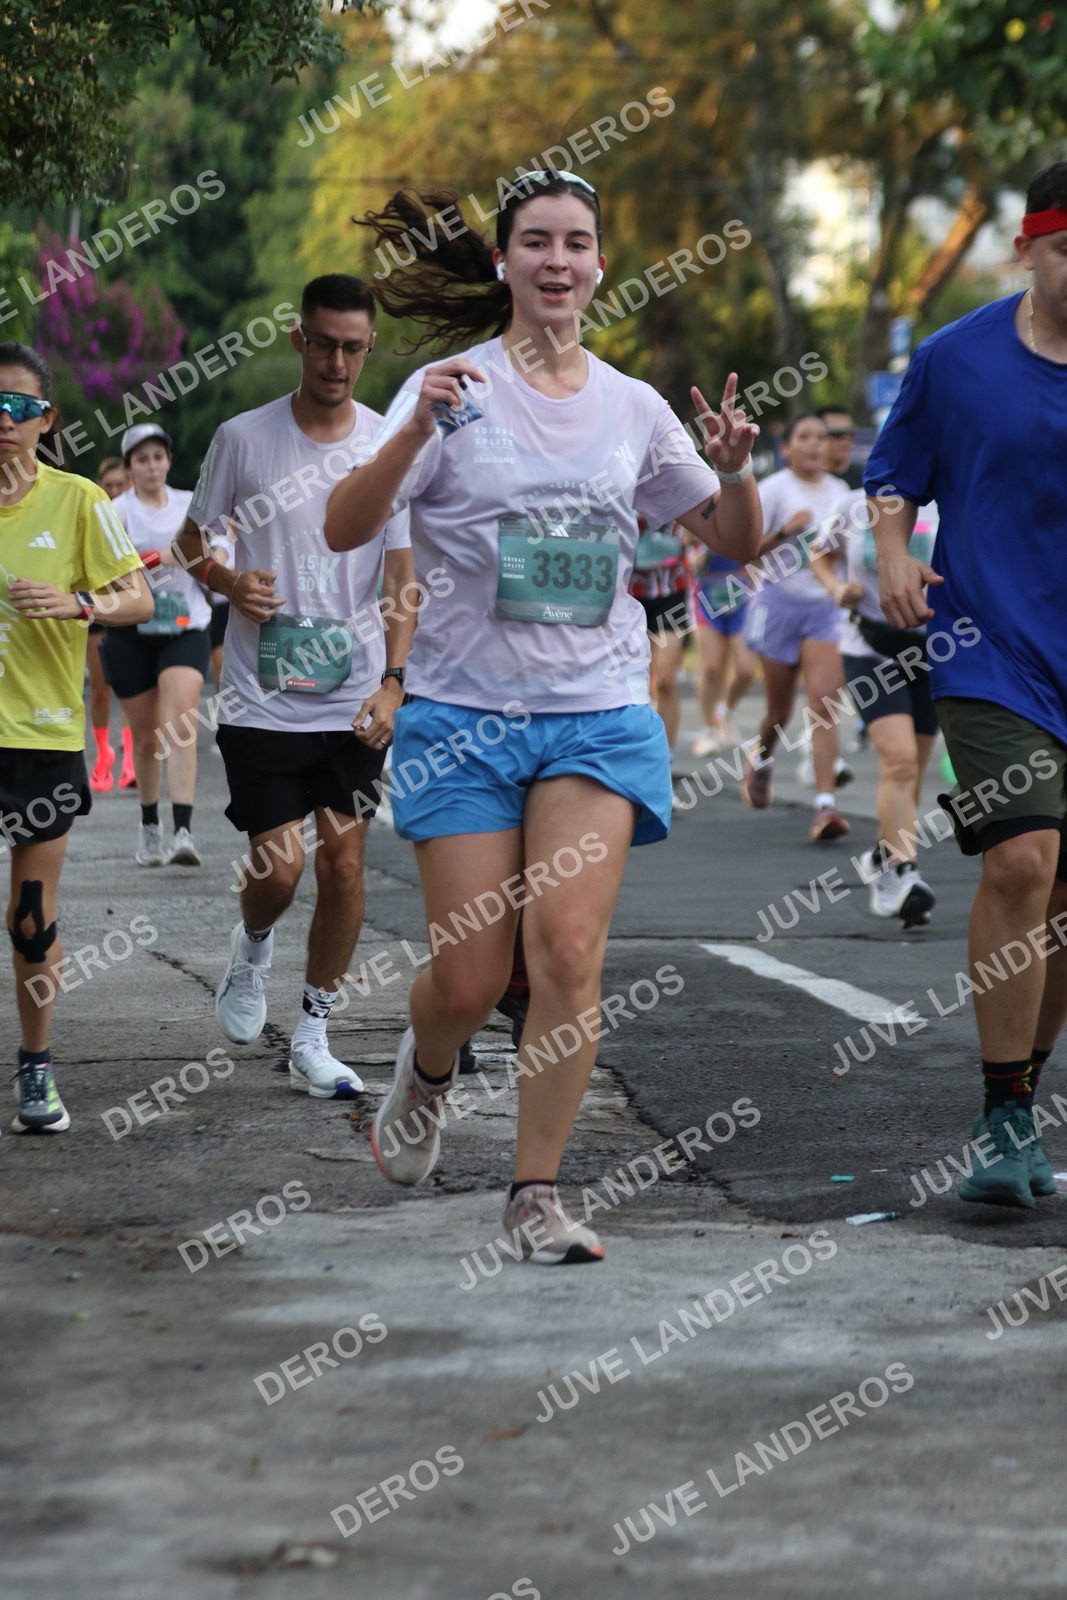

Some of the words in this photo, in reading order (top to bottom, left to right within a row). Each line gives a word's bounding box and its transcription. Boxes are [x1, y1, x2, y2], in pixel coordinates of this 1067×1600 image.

[298, 554, 317, 570] 15
[319, 556, 341, 593] K
[531, 550, 613, 593] 3333
[297, 577, 315, 592] 30
